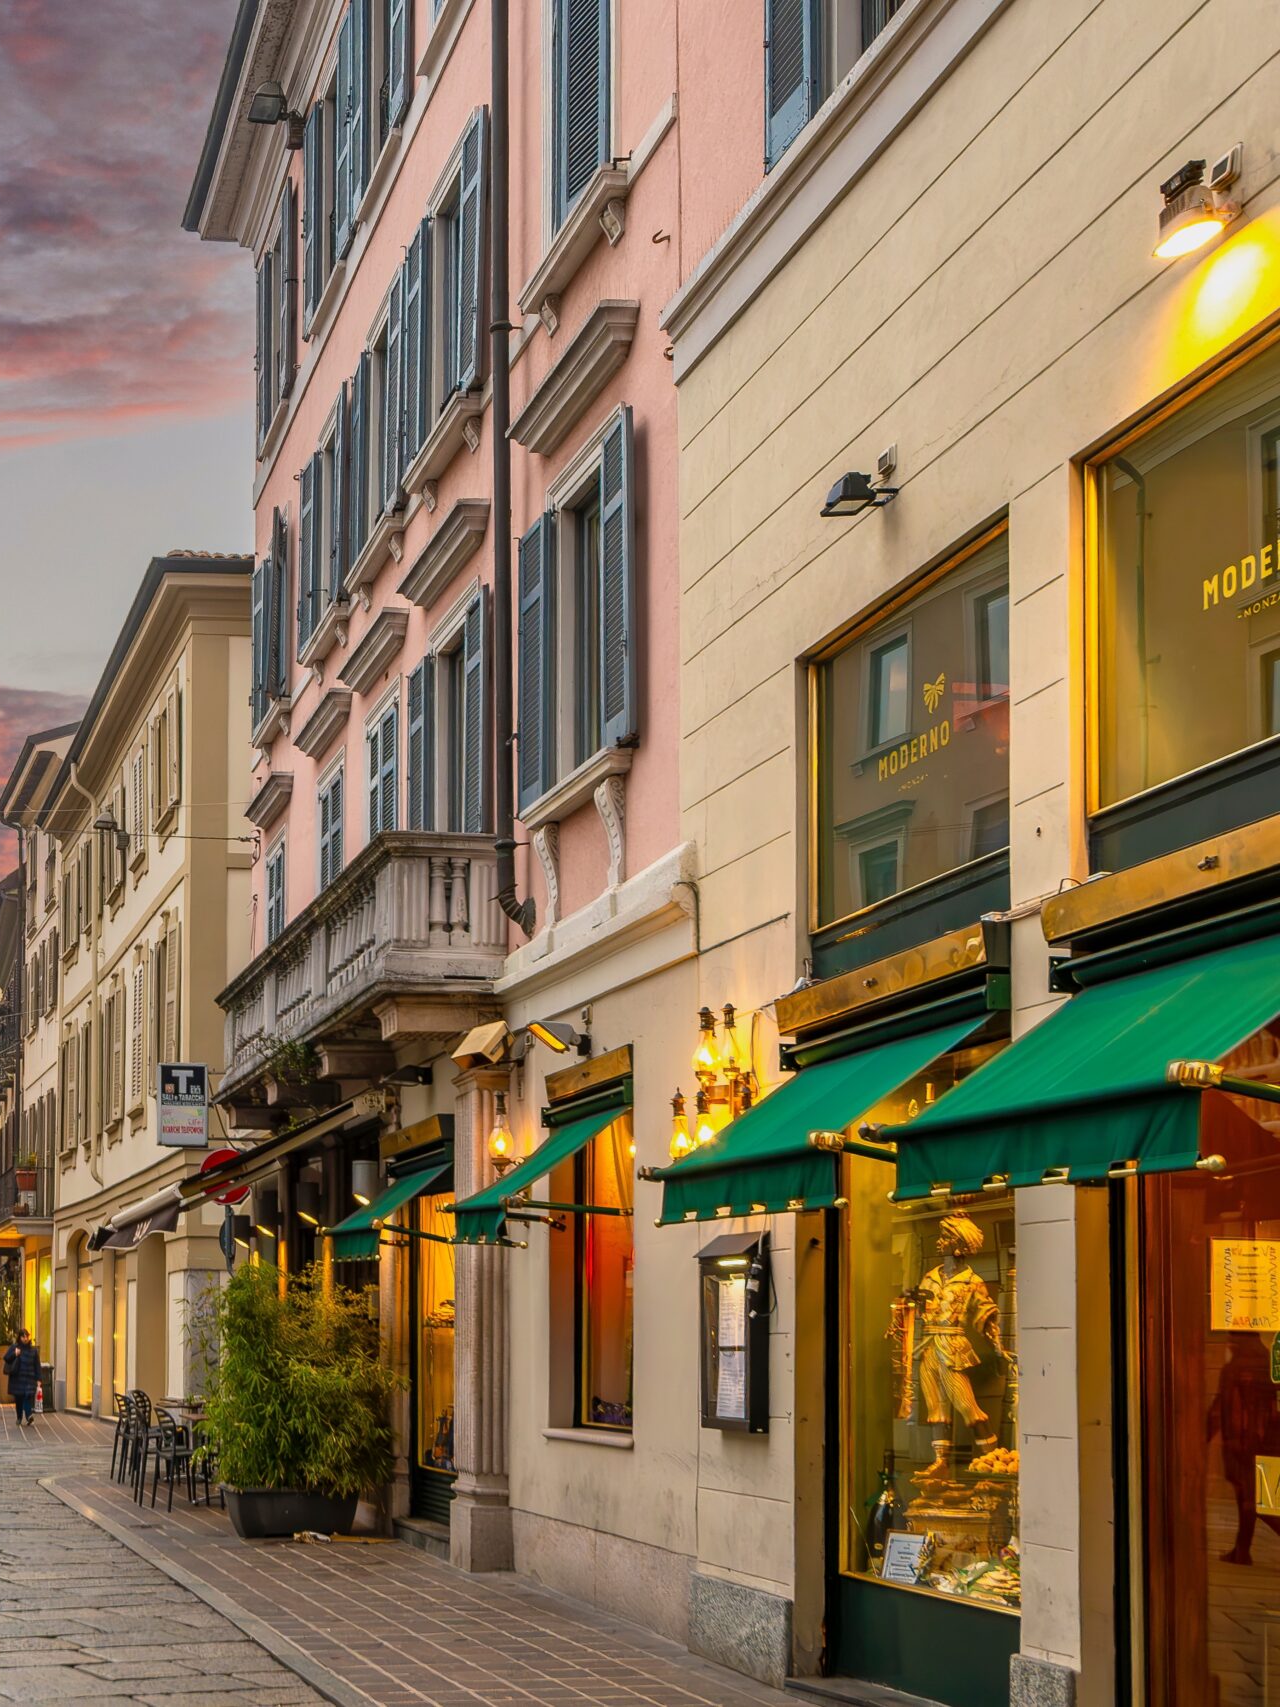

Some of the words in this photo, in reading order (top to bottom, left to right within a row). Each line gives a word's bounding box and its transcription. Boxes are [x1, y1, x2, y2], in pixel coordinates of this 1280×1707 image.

[1202, 540, 1280, 611] MODE
[878, 719, 950, 782] MODERNO
[171, 1069, 194, 1094] T
